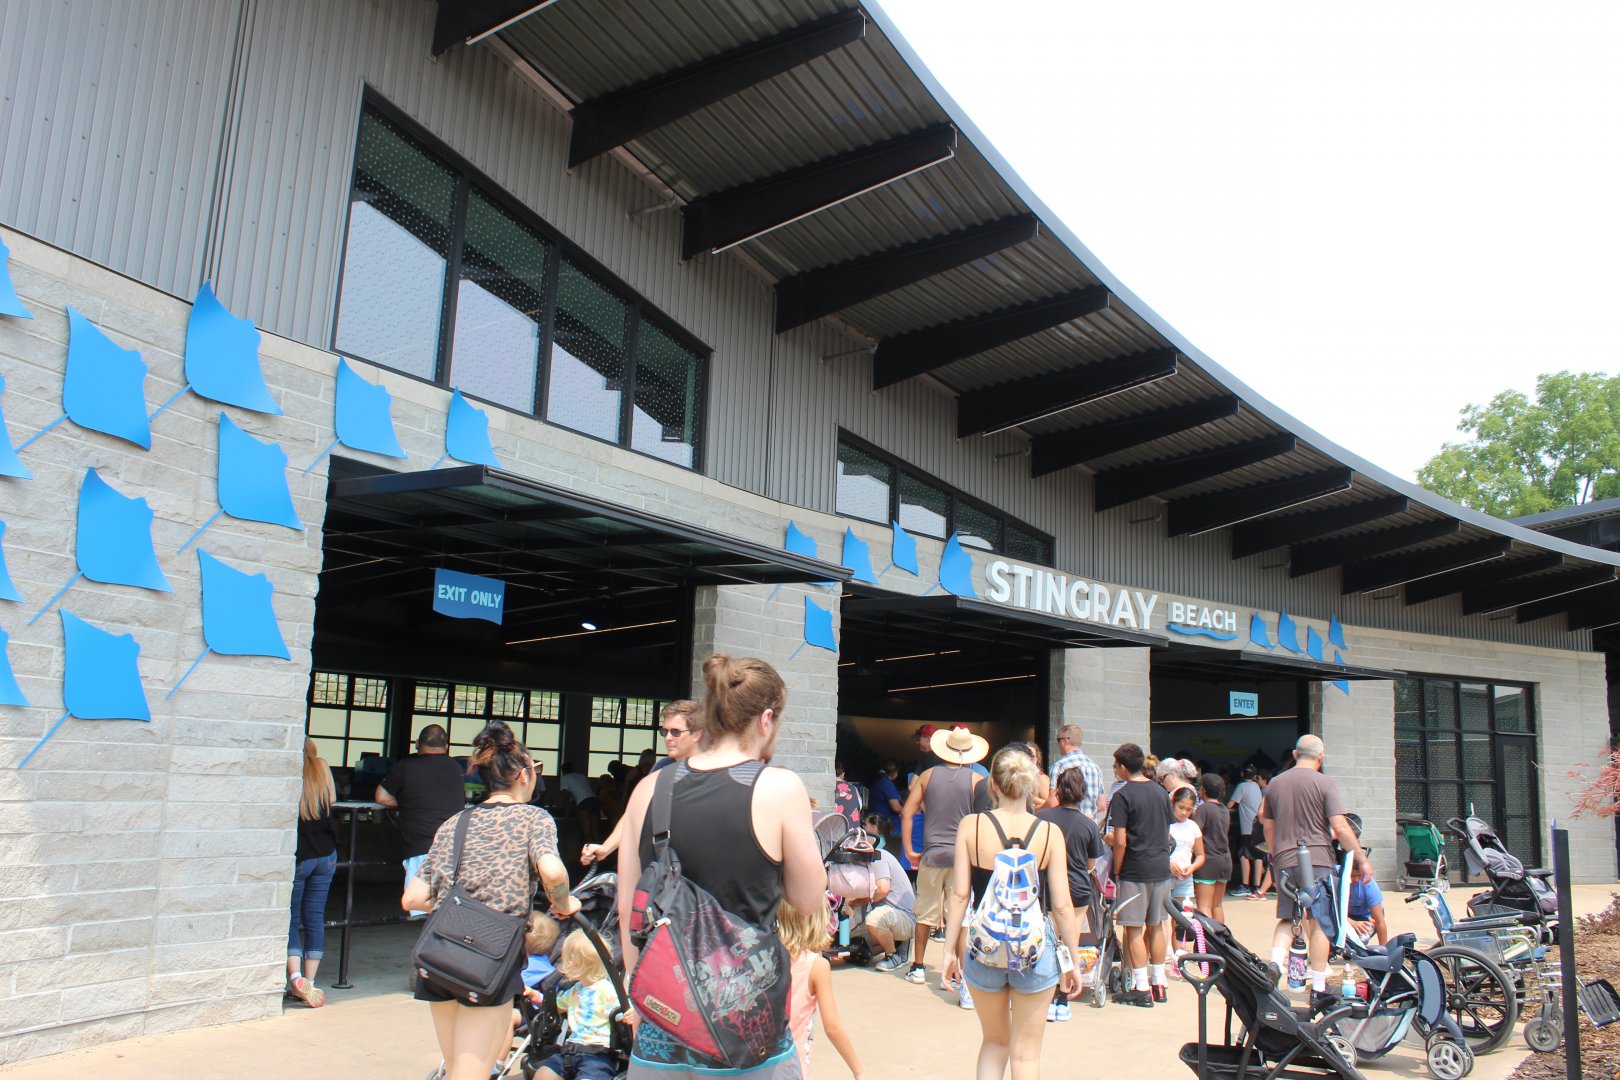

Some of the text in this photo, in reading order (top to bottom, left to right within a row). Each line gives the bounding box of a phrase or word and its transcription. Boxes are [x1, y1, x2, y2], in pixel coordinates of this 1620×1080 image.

[438, 584, 501, 608] EXIT ONLY
[985, 560, 1236, 631] STINGRAY BEACH
[1233, 698, 1255, 710] ENTER
